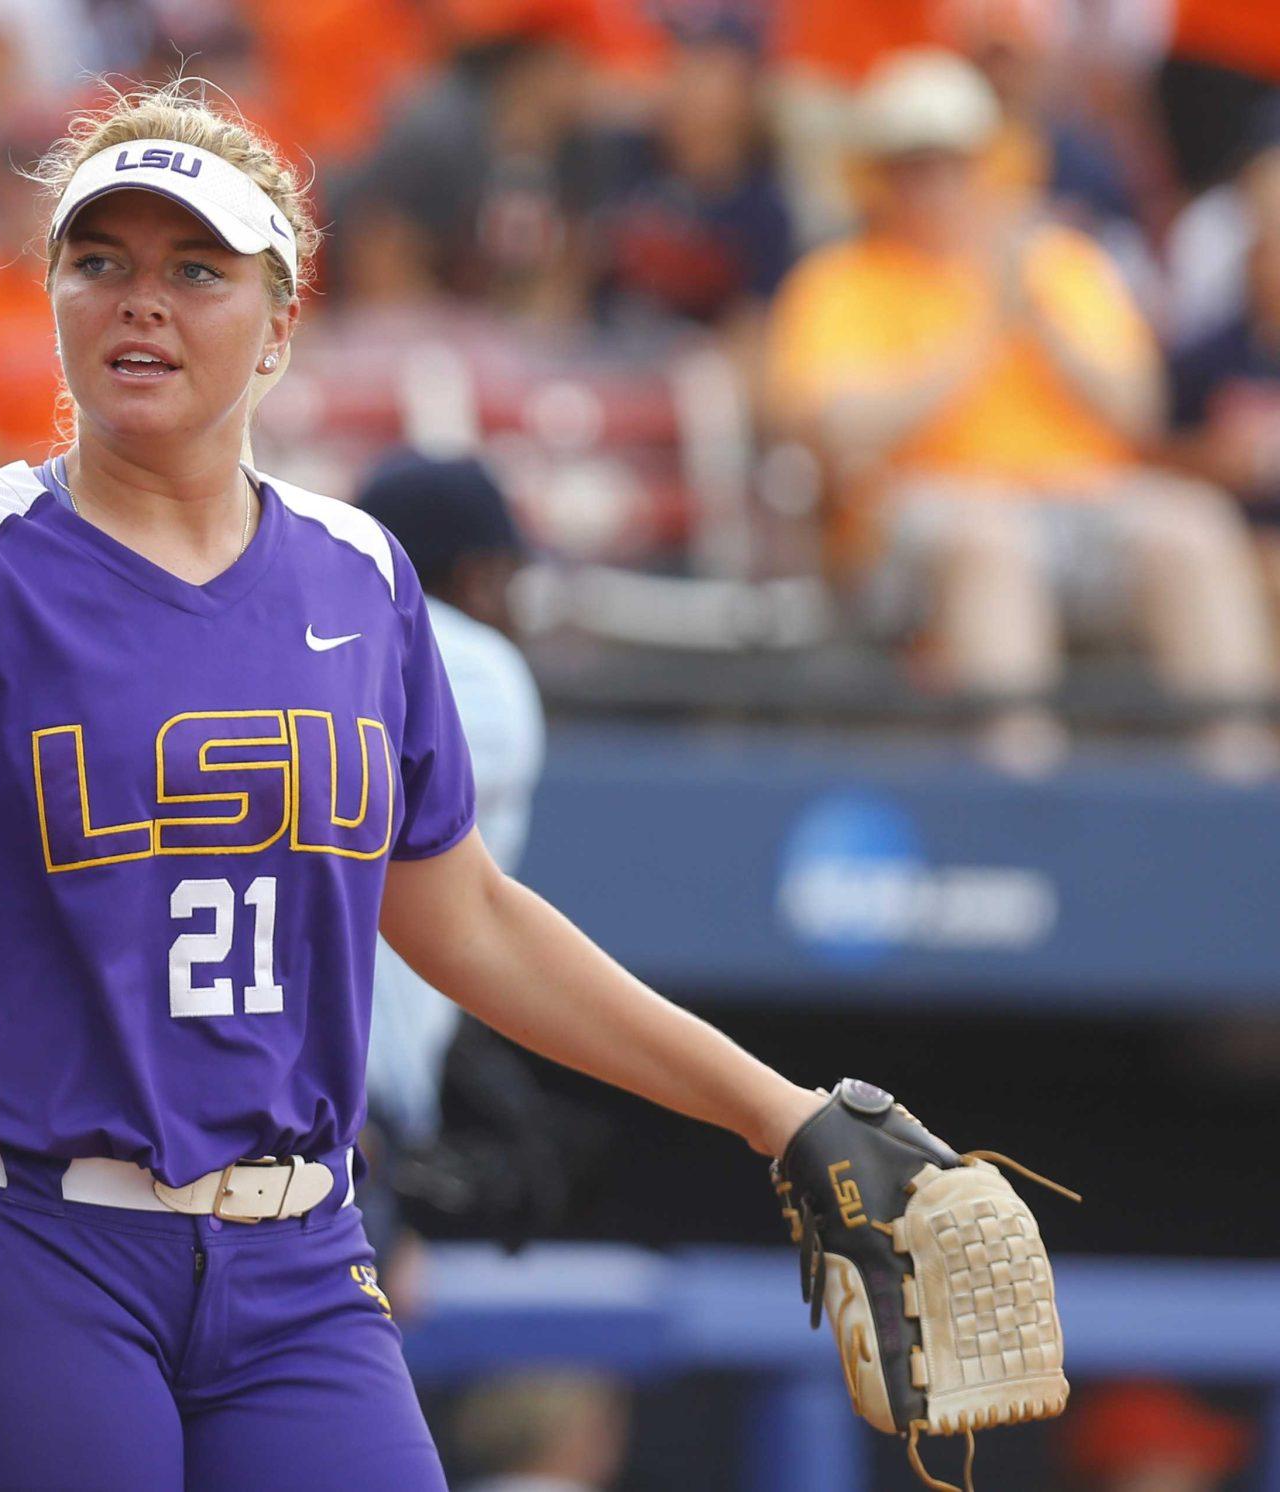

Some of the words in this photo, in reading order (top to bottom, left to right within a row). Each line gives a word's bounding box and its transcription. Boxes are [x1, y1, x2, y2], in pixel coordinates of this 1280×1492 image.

[115, 148, 202, 178] LSU
[32, 709, 394, 873] LSU
[168, 876, 283, 1018] 21
[827, 1159, 869, 1231] LSU
